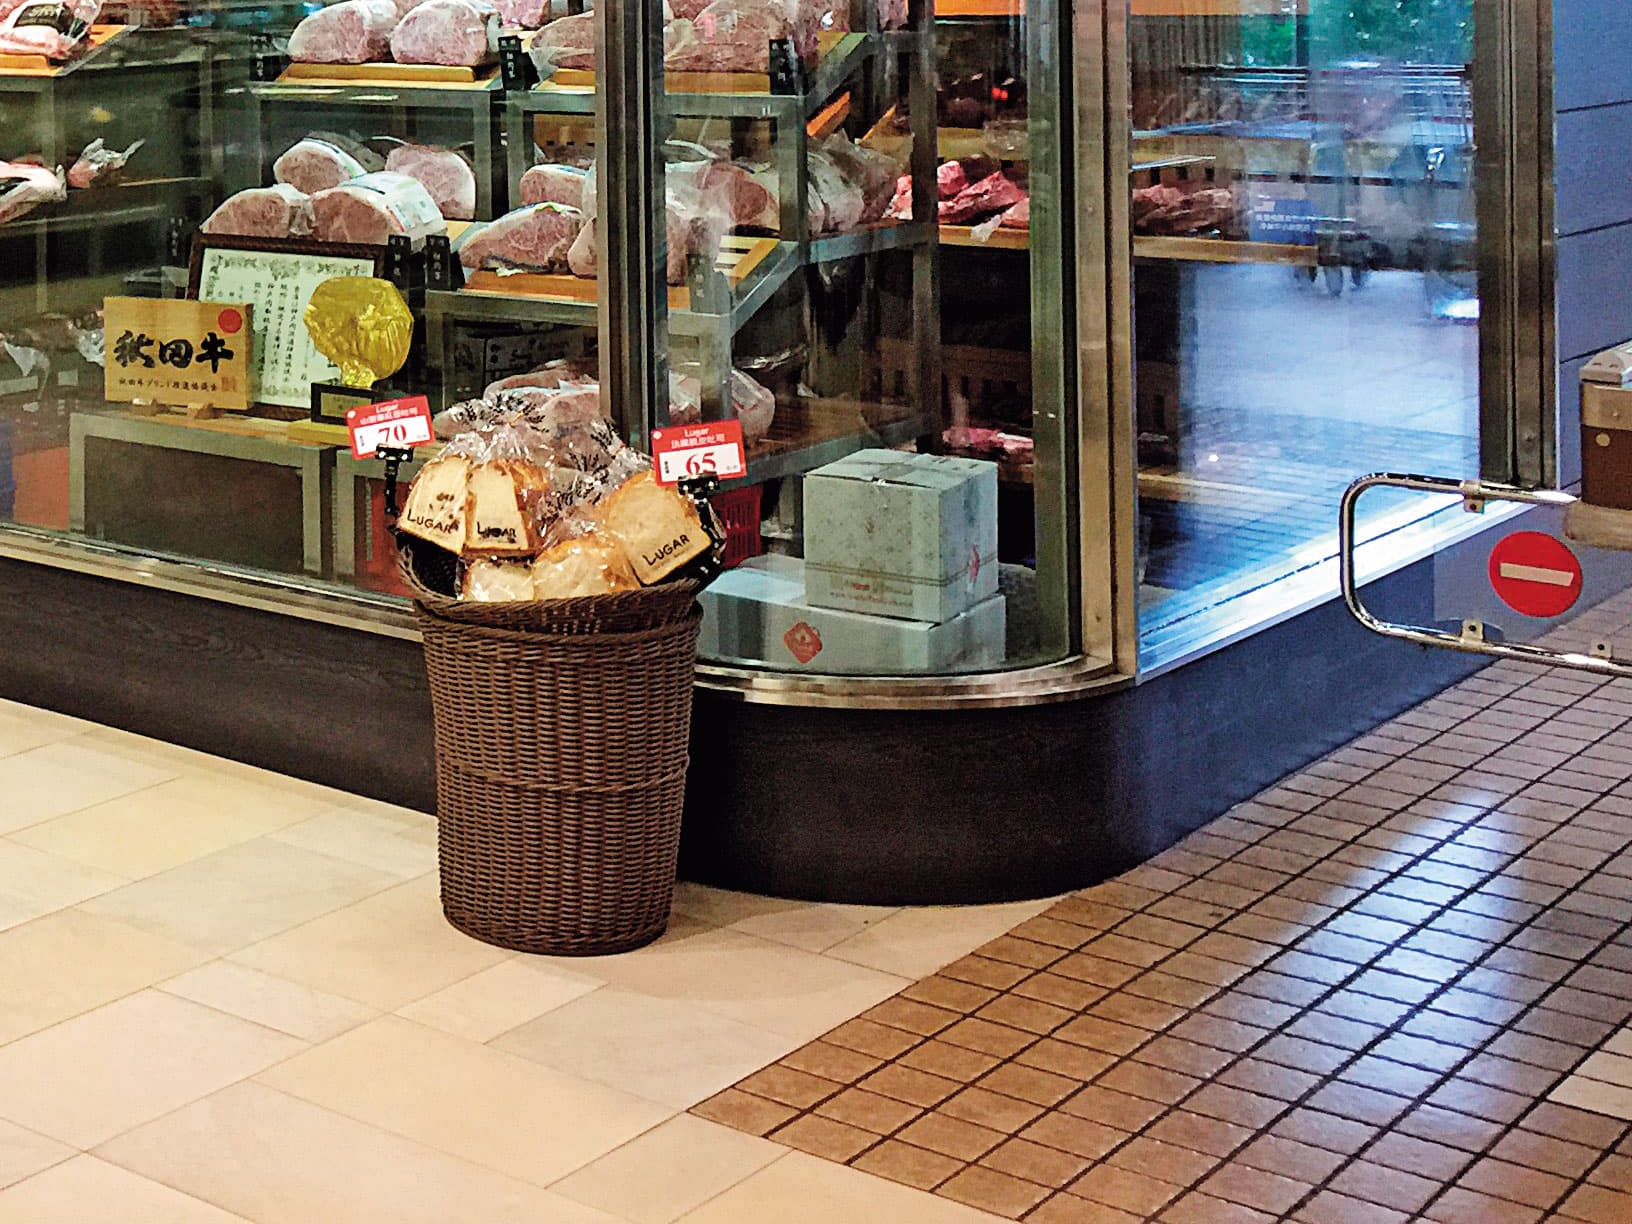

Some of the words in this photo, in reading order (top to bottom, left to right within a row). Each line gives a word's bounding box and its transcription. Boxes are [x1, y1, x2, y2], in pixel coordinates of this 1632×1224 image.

[113, 330, 234, 374] 秋田牛
[378, 424, 407, 443] 70
[685, 452, 716, 475] 65
[407, 509, 459, 533] LUGAR
[643, 533, 690, 567] LUGAR
